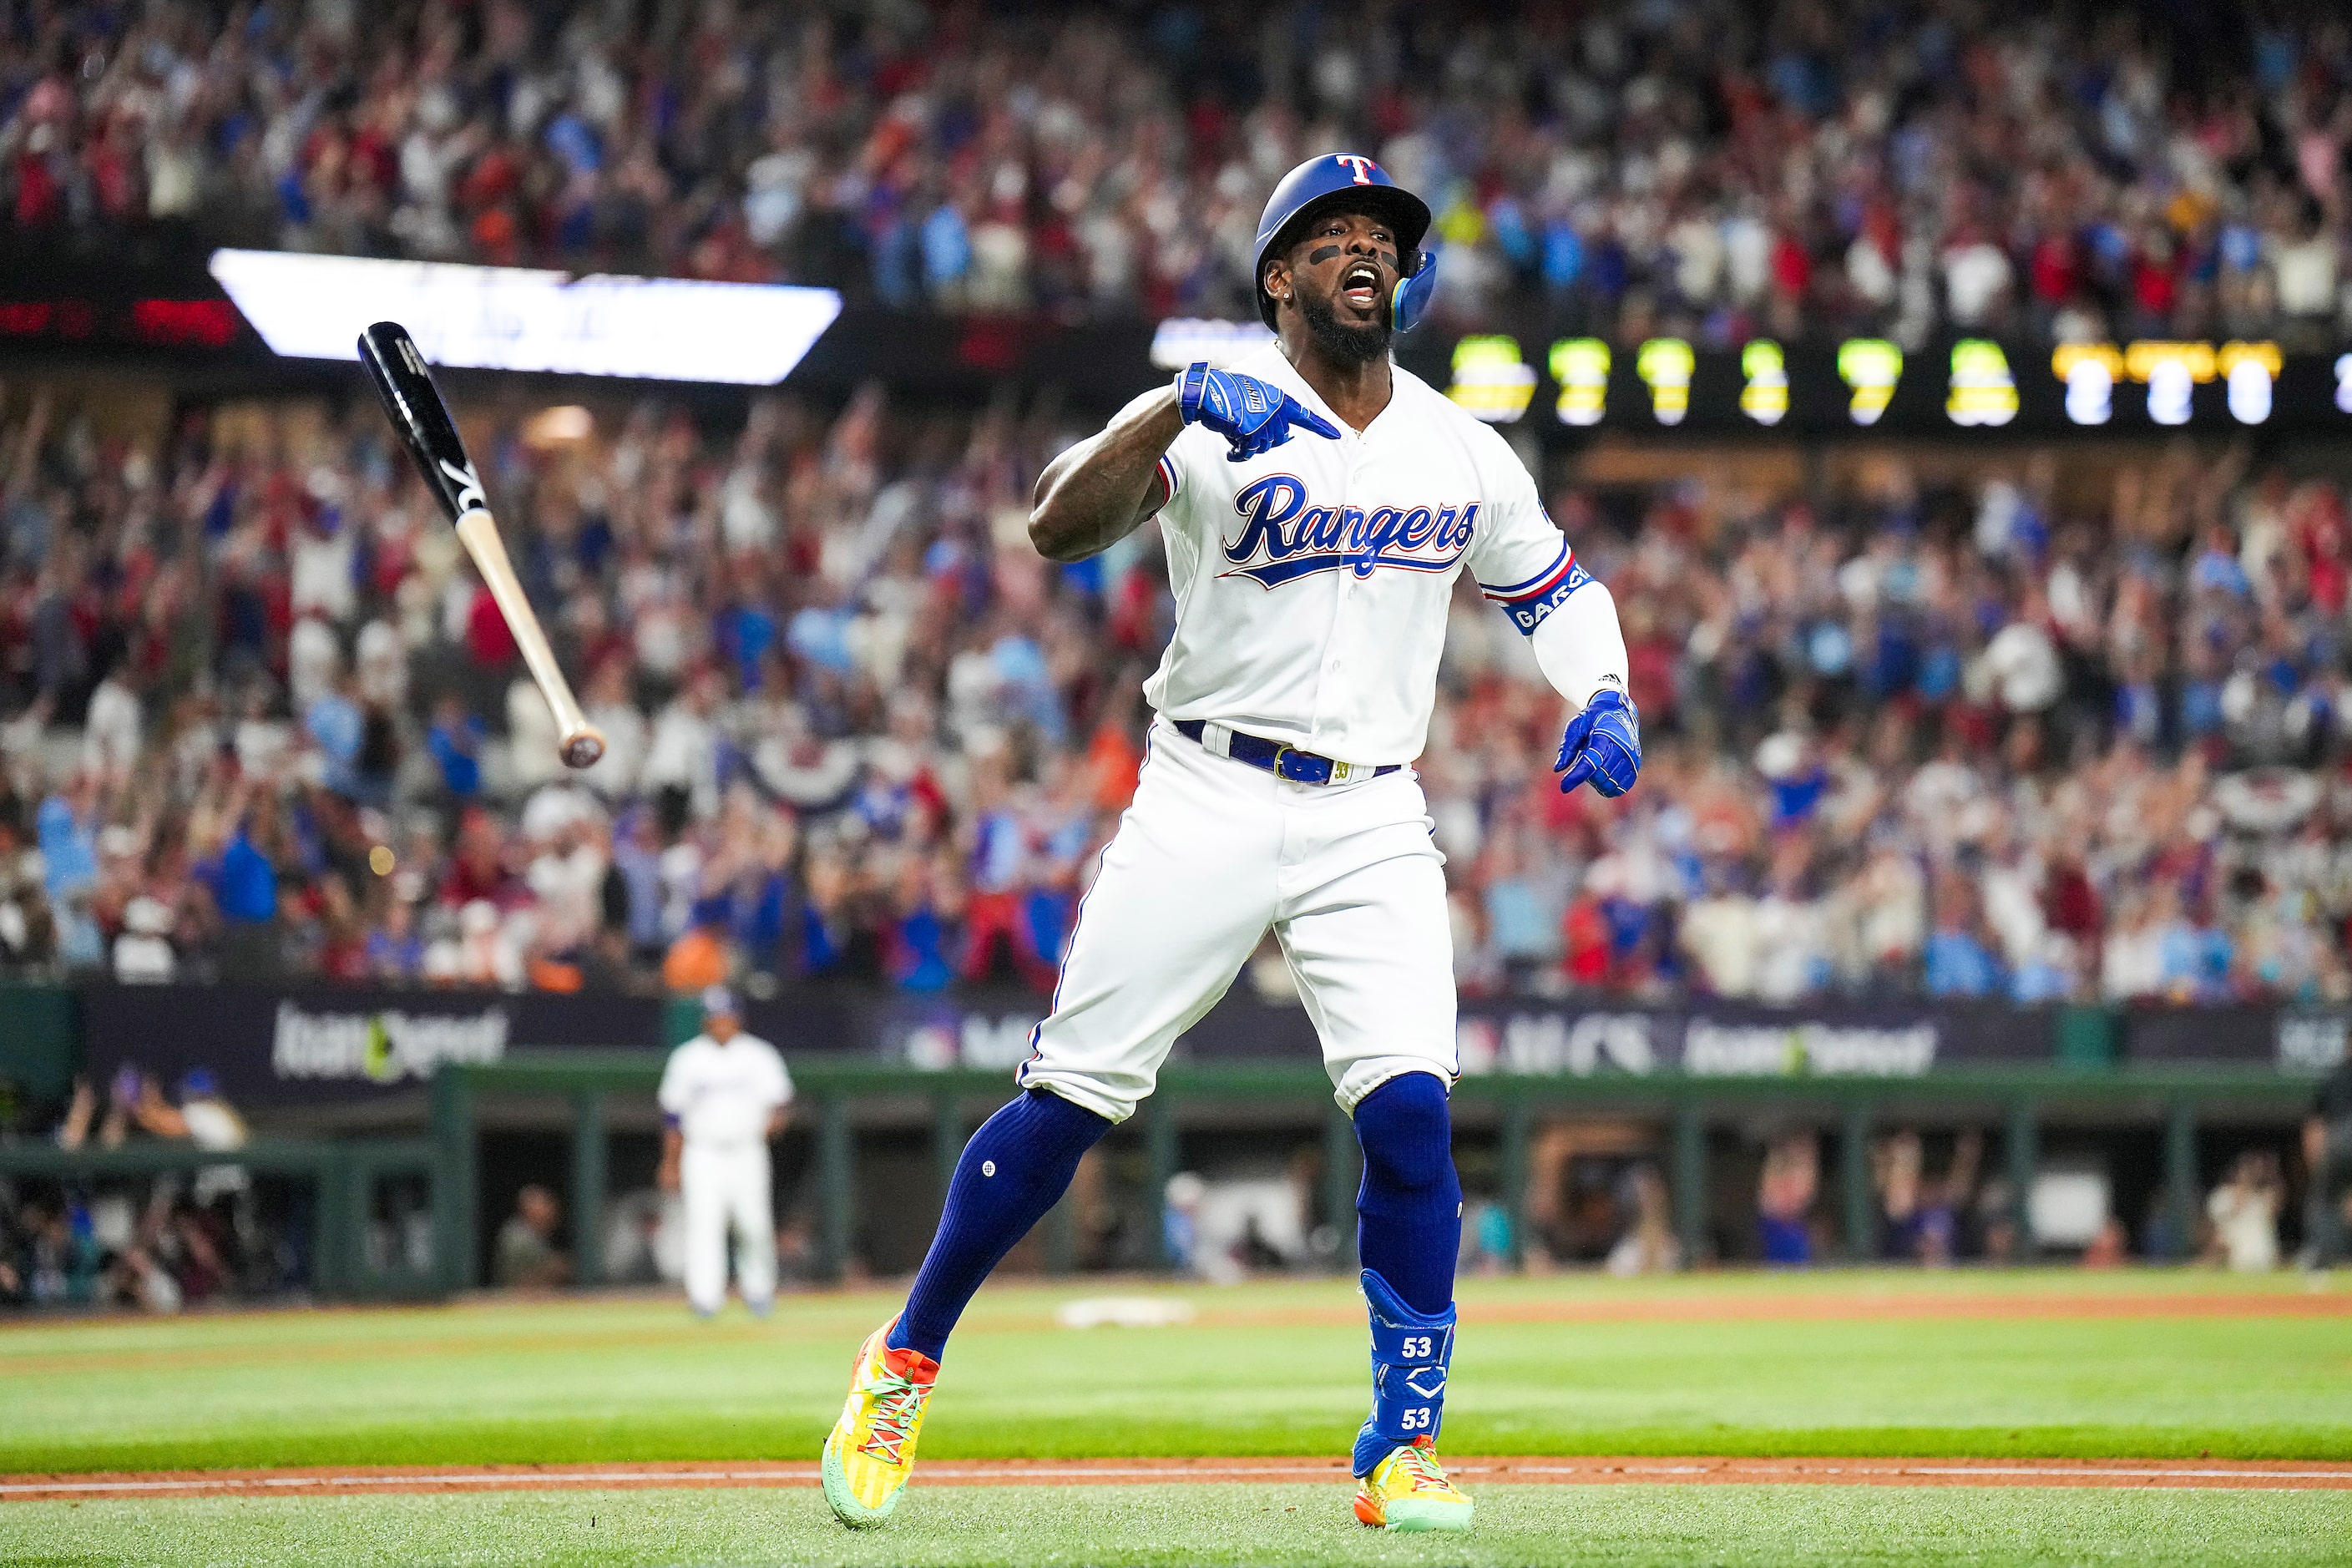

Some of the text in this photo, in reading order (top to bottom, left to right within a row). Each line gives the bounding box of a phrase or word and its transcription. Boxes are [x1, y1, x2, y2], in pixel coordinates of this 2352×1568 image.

[1336, 155, 1376, 185] T
[1222, 473, 1481, 579] Rangers
[1335, 761, 1349, 779] 53
[1402, 1336, 1432, 1358] 53
[1401, 1407, 1430, 1430] 53
